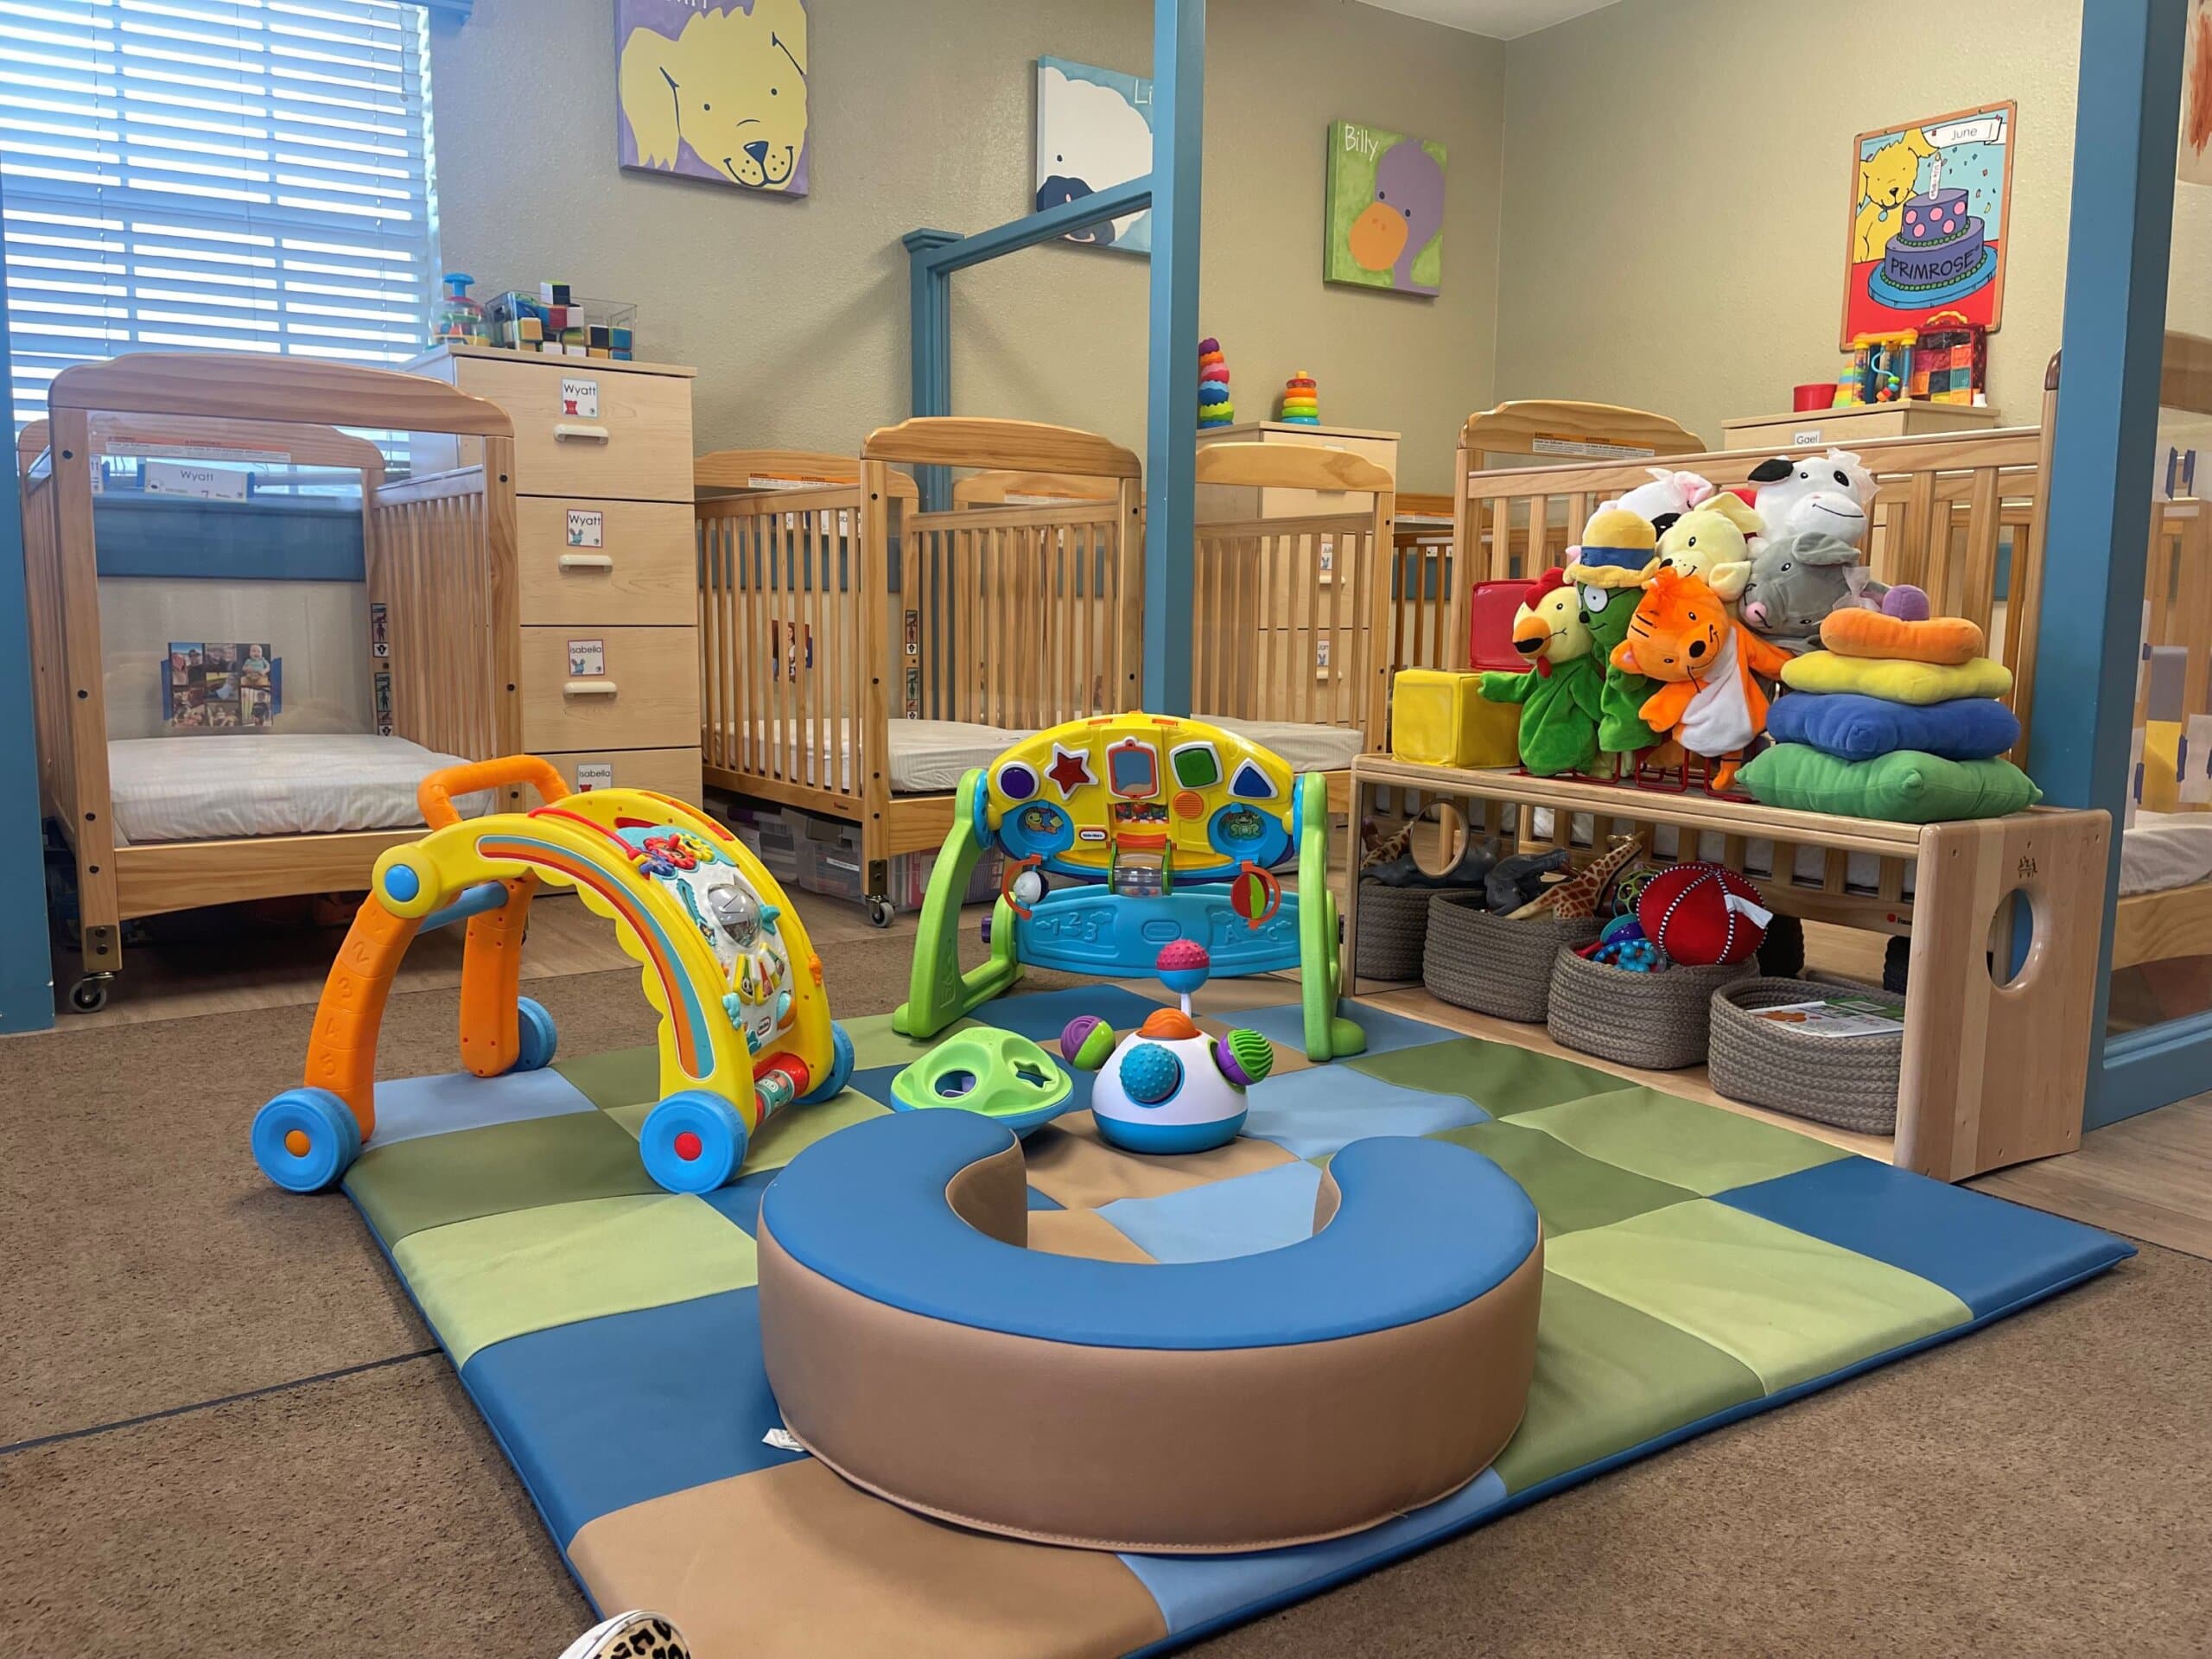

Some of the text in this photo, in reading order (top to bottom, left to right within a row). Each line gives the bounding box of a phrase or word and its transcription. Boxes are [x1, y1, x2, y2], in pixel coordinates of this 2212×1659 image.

[1134, 79, 1154, 105] Li
[1951, 126, 1978, 141] June
[1345, 124, 1379, 162] Billy
[1890, 251, 1975, 280] PRIMROSE
[563, 383, 596, 397] Wyatt
[1796, 435, 1818, 444] Gael
[180, 469, 214, 482] Wyatt
[569, 513, 601, 527] Wyatt
